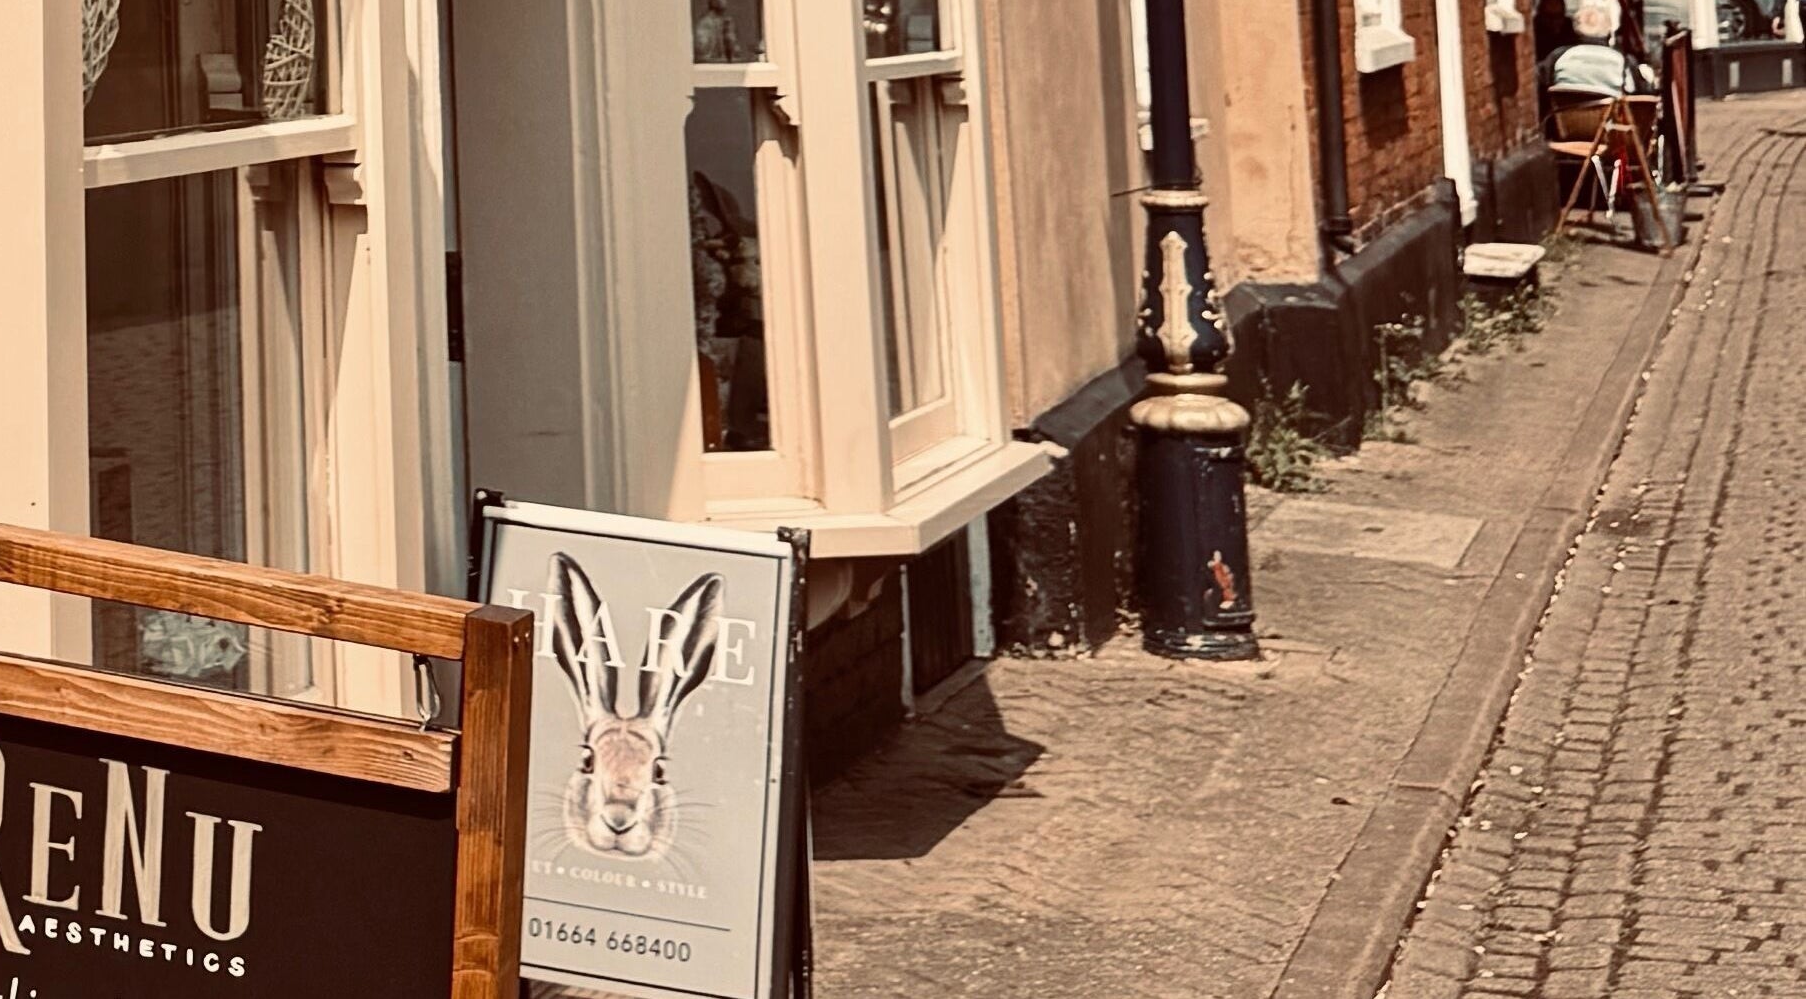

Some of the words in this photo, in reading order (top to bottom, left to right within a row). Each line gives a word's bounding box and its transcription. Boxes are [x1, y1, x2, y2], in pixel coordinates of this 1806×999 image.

[507, 588, 756, 686] HARE
[569, 866, 637, 888] COLOUR
[656, 880, 707, 900] STYLE
[18, 914, 246, 978] AESTHETICS
[528, 917, 596, 947] 01664
[606, 930, 692, 963] 668400
